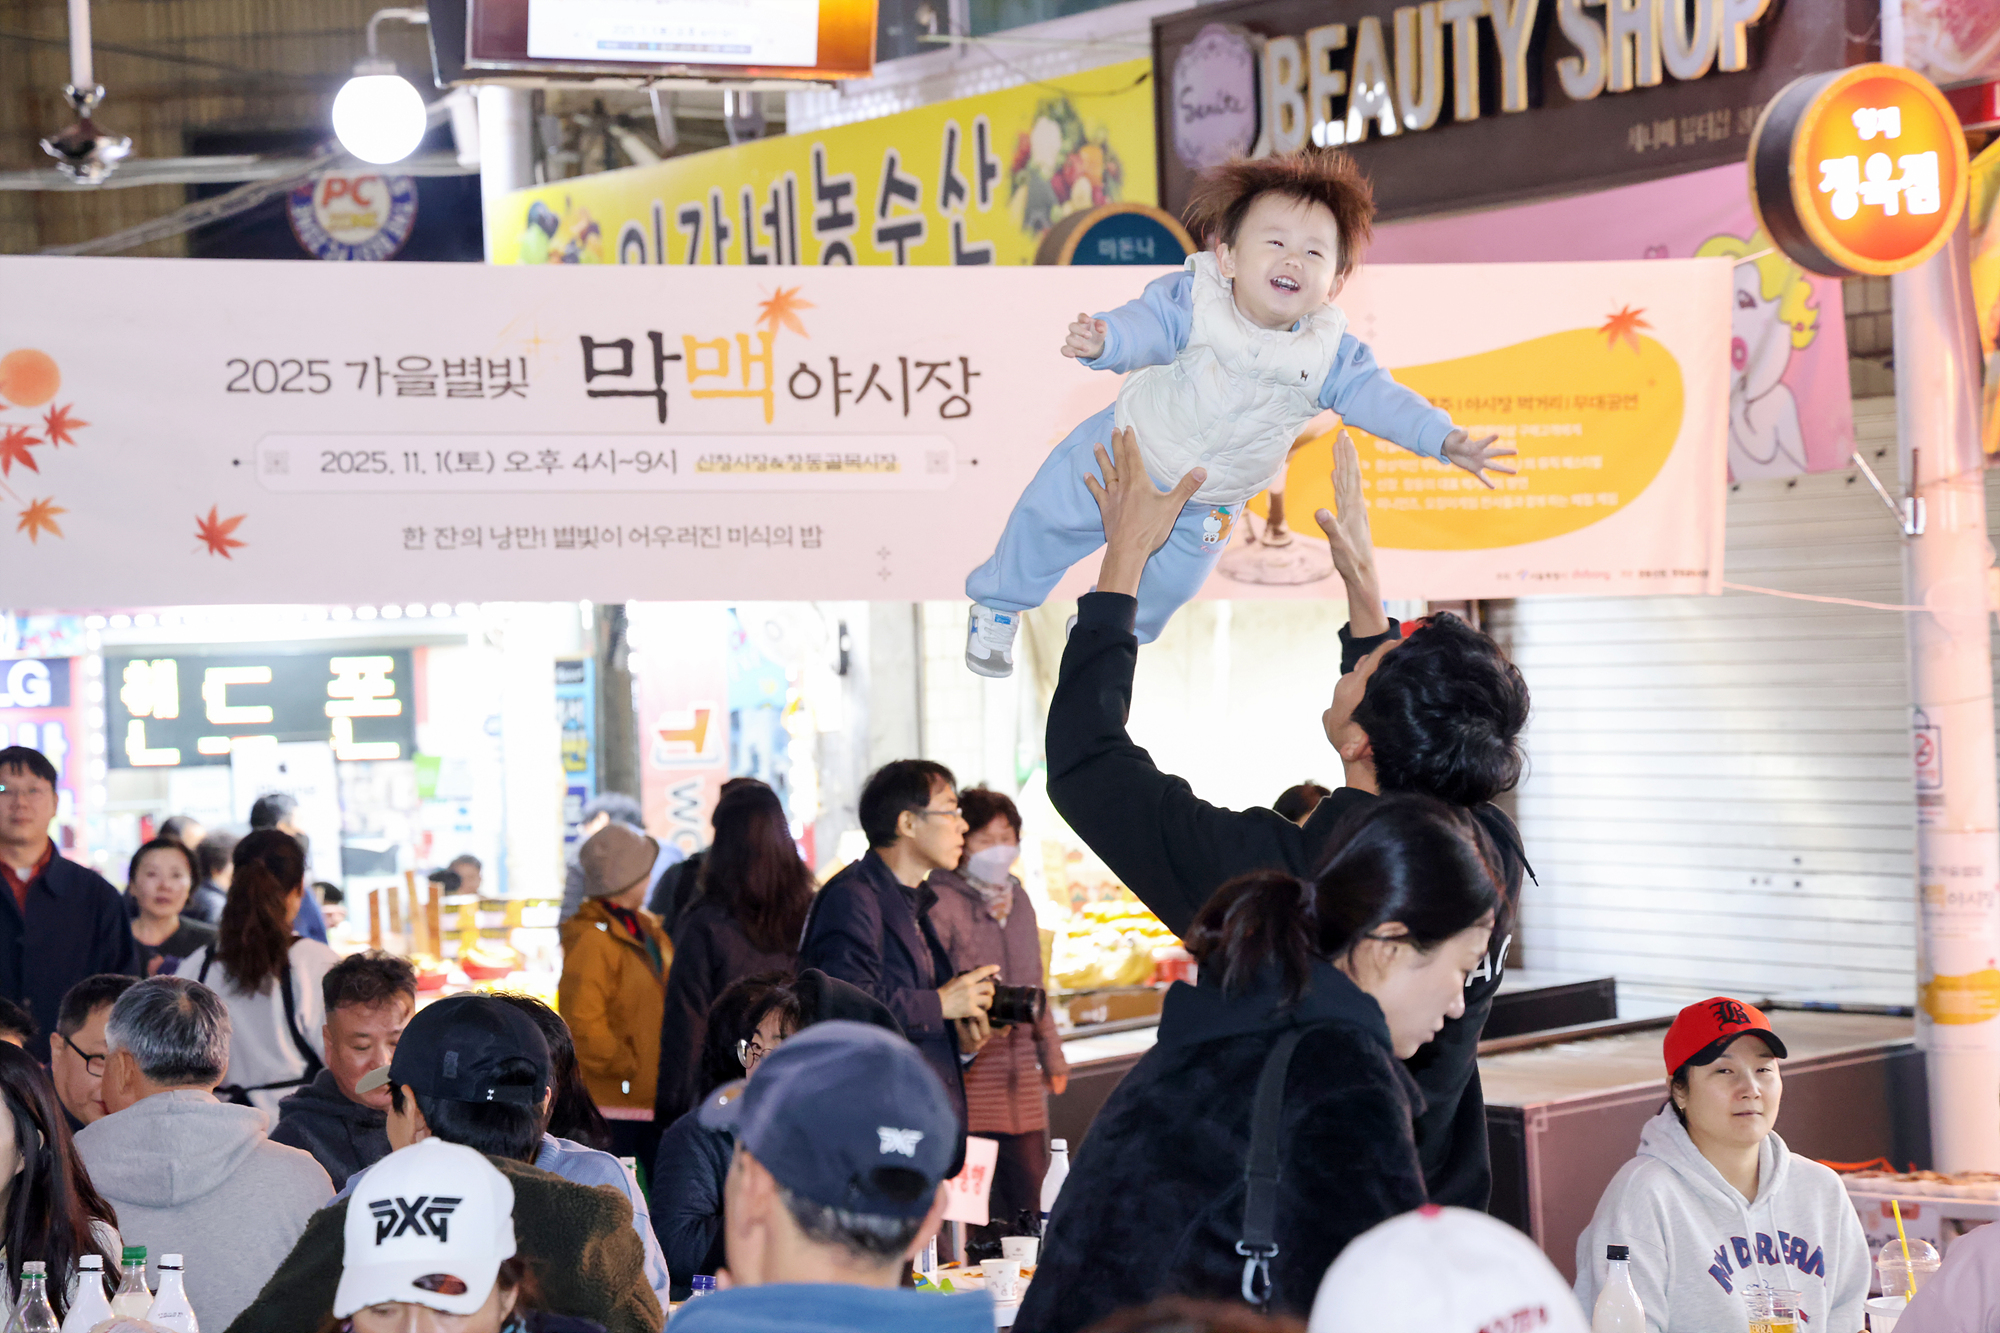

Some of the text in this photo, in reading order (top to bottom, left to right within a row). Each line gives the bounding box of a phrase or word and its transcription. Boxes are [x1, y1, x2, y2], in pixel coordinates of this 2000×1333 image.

[1264, 0, 1766, 153] BEAUTY SHOP
[225, 358, 332, 394] 2025
[345, 355, 530, 399] 가을별빛
[320, 451, 395, 475] 2025.
[503, 450, 564, 476] 오후
[402, 526, 426, 550] 한
[434, 526, 483, 549] 잔의
[552, 526, 622, 549] 별빛이
[628, 525, 722, 548] 어우러진
[728, 525, 793, 547] 미식의
[800, 525, 823, 547] 밤
[120, 655, 402, 767] 핸드폰
[368, 1196, 463, 1246] PXG
